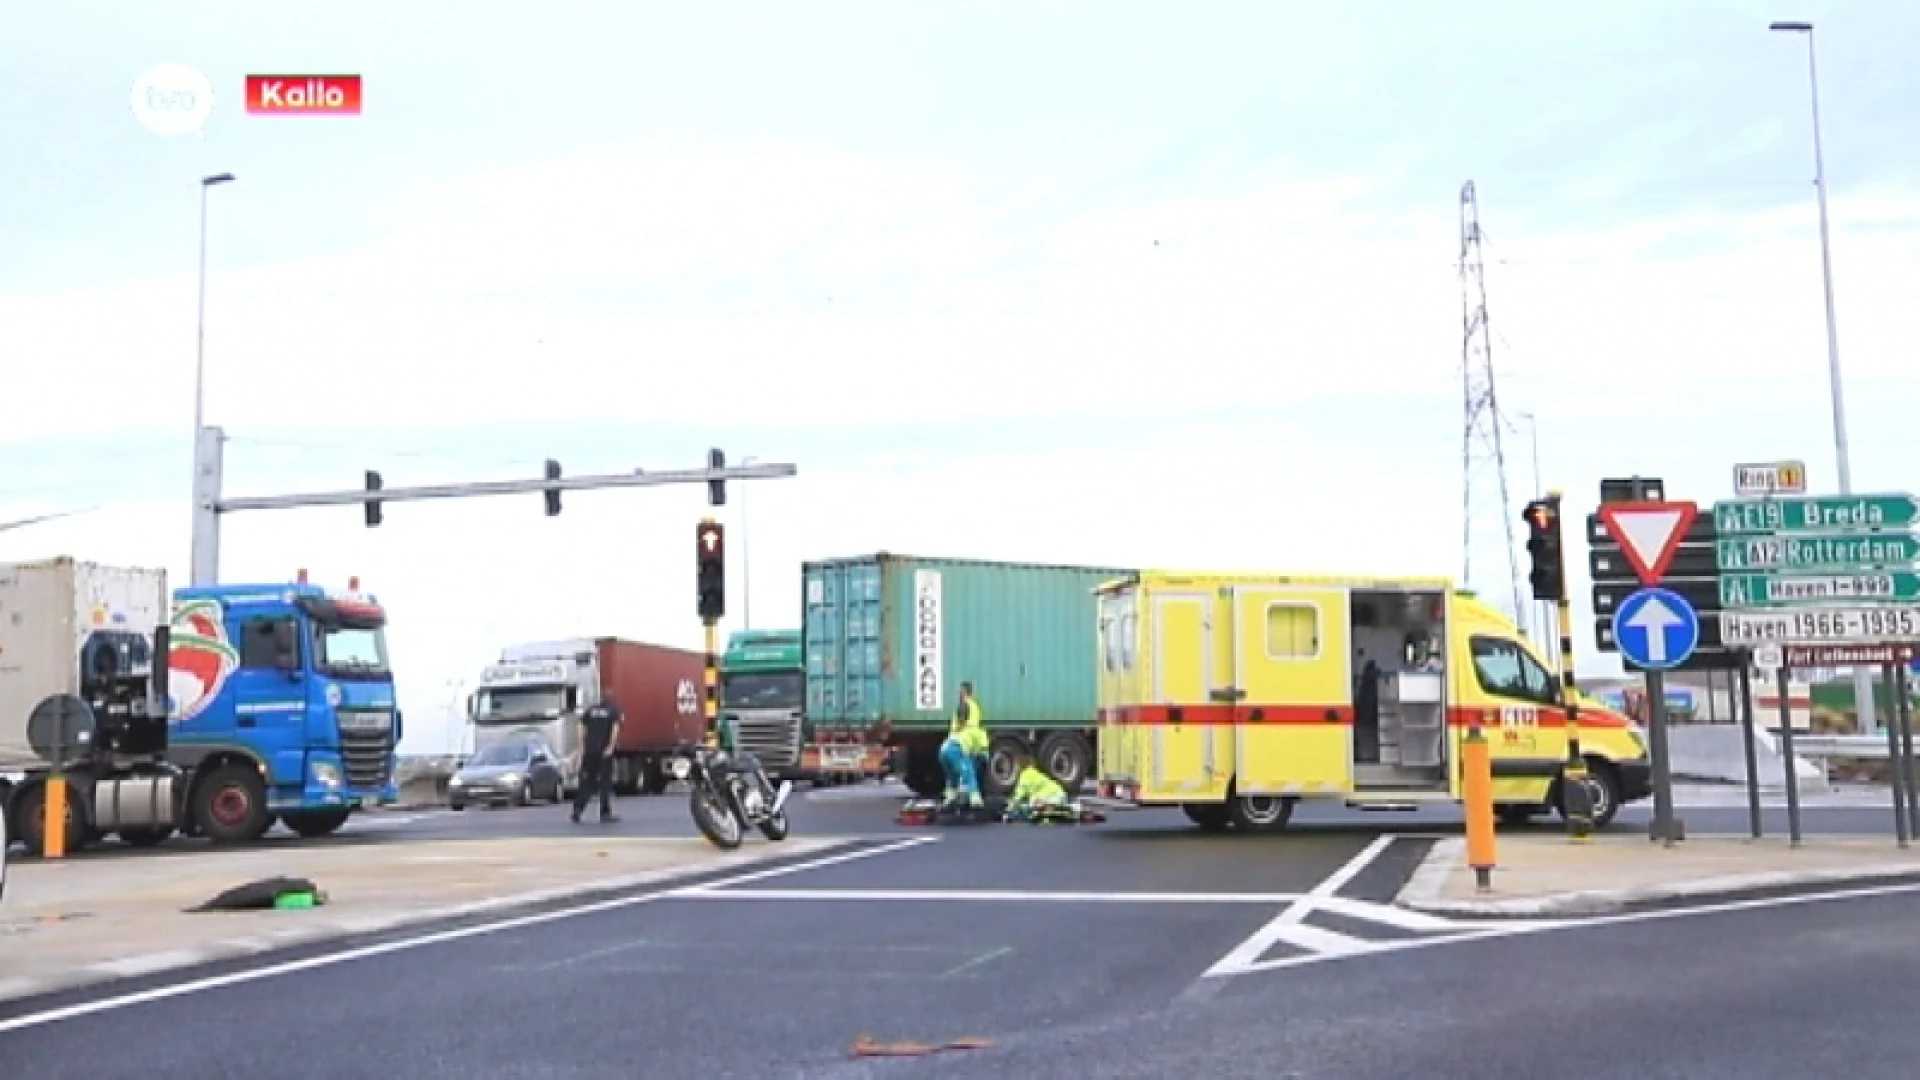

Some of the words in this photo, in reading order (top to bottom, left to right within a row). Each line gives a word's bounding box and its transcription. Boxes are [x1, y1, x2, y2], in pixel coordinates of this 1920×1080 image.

[1804, 500, 1883, 525] Breda
[1787, 538, 1904, 563] Rotterdam
[1770, 578, 1827, 596] Haven
[1727, 615, 1787, 639] Haven
[1794, 611, 1914, 638] 1966-1995
